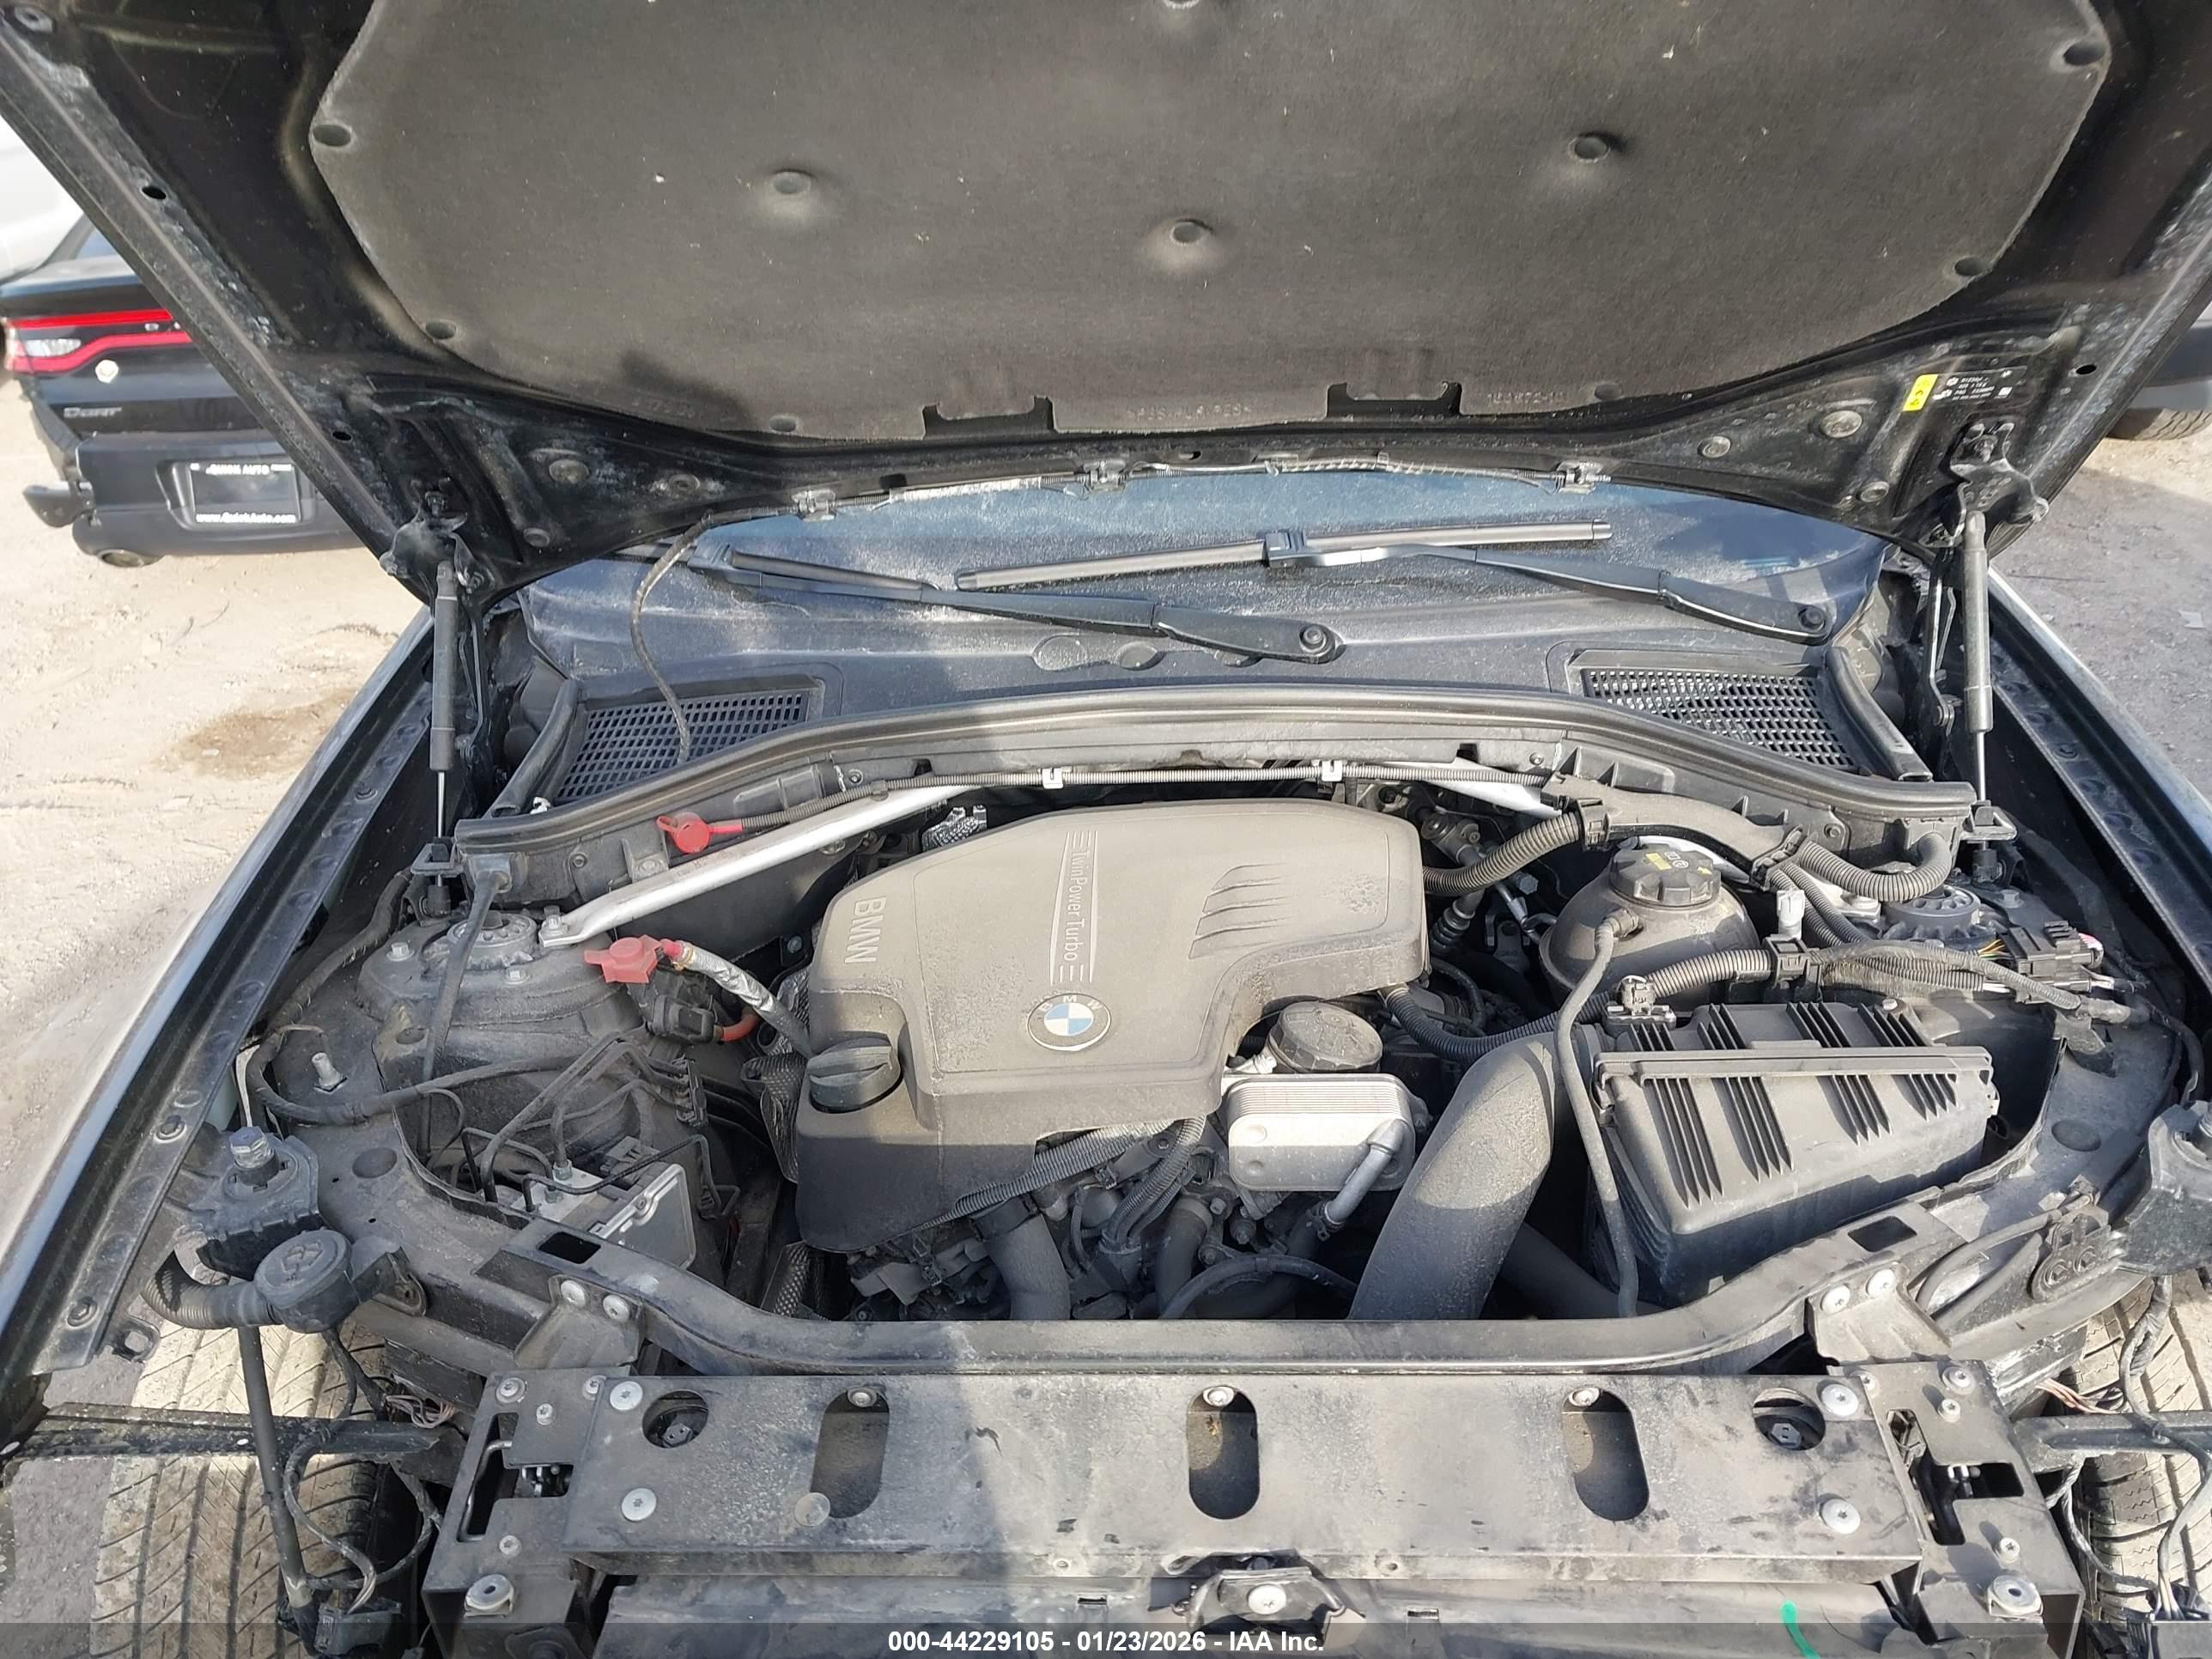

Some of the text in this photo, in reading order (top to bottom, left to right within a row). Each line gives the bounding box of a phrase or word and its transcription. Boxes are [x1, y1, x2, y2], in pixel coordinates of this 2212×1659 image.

[242, 464, 270, 476] AUTO
[1063, 849, 1091, 962] TwinPower Turbo
[844, 896, 887, 963] BMW
[1038, 994, 1103, 1012] BMW
